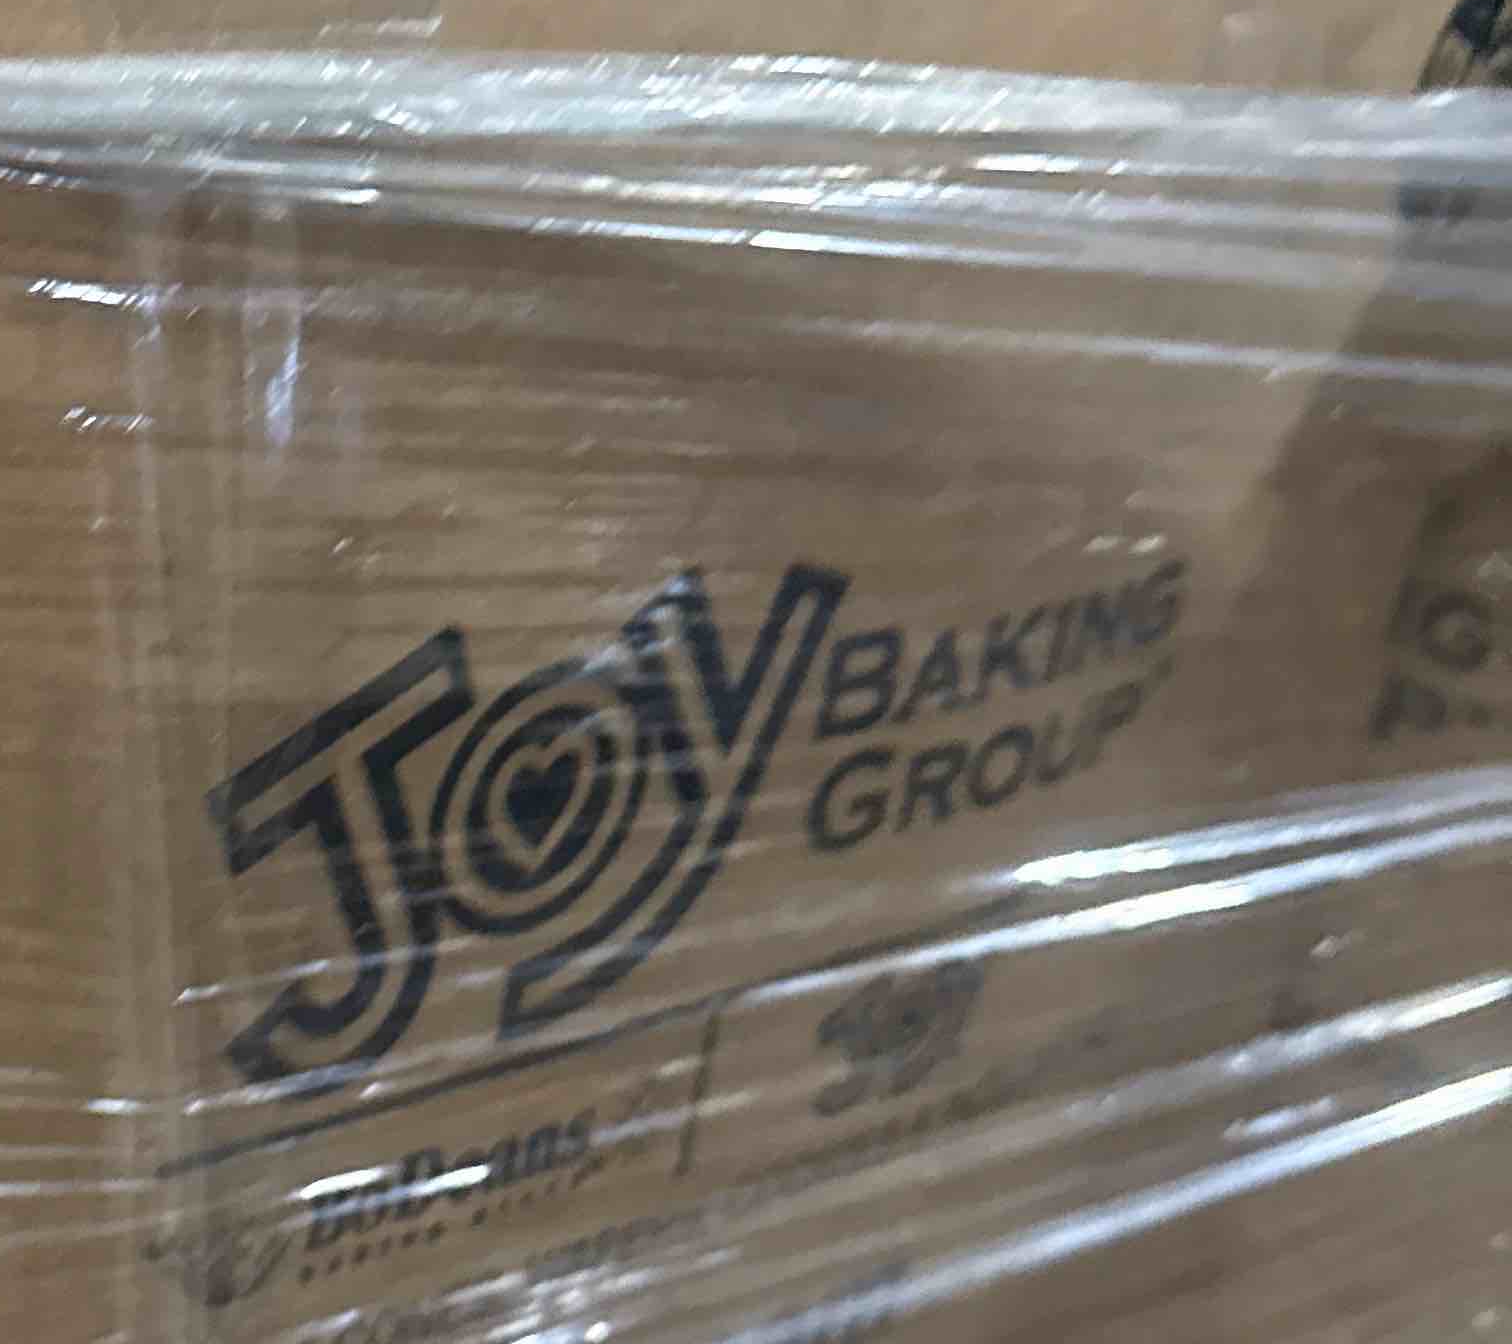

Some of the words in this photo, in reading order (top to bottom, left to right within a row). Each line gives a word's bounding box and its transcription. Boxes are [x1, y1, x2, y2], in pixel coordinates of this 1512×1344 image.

[813, 559, 1187, 742] BAKING
[204, 562, 852, 1098] JOY
[806, 678, 1150, 852] GROUP
